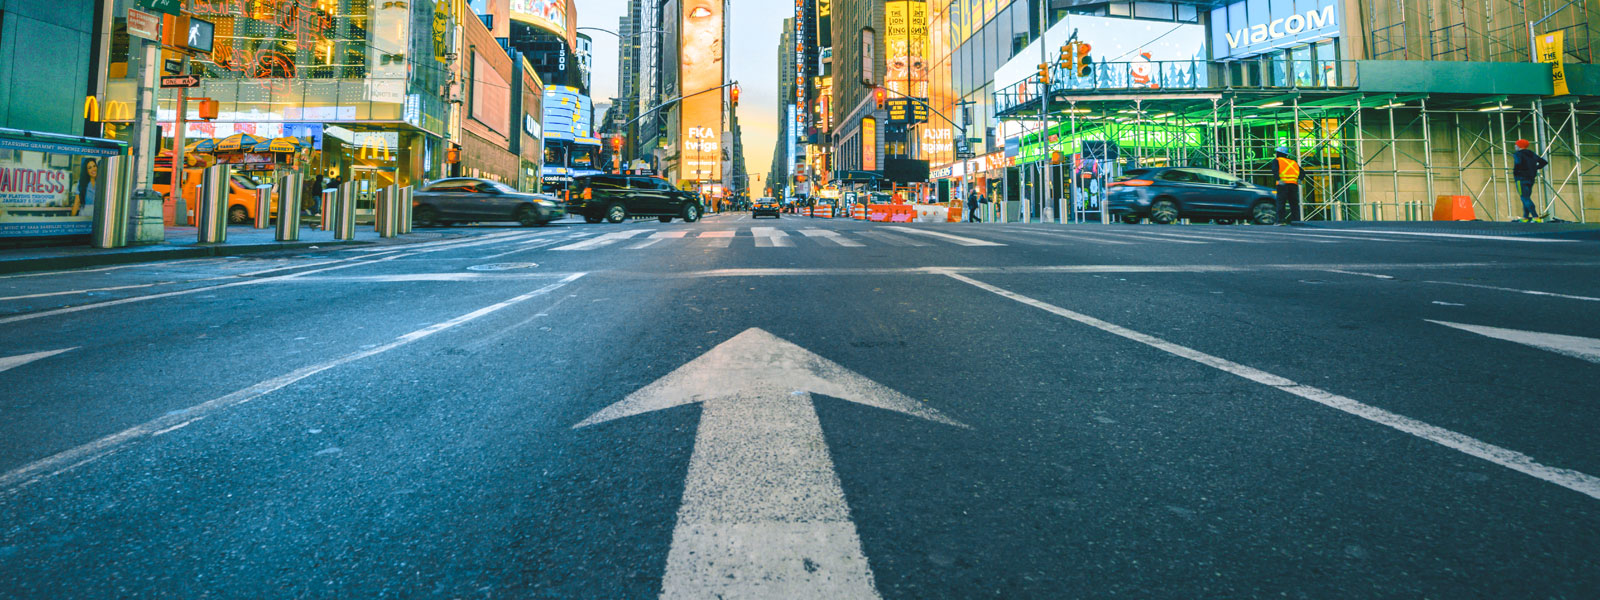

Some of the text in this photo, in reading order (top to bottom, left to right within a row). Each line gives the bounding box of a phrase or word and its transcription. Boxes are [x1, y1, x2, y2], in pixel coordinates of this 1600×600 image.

[889, 17, 903, 25] LION
[888, 26, 906, 36] KING
[1544, 52, 1556, 60] THE
[688, 127, 715, 139] FKA
[1119, 130, 1196, 144] LINE FRIENDS
[685, 139, 718, 153] twigs
[0, 168, 65, 194] AITRESS
